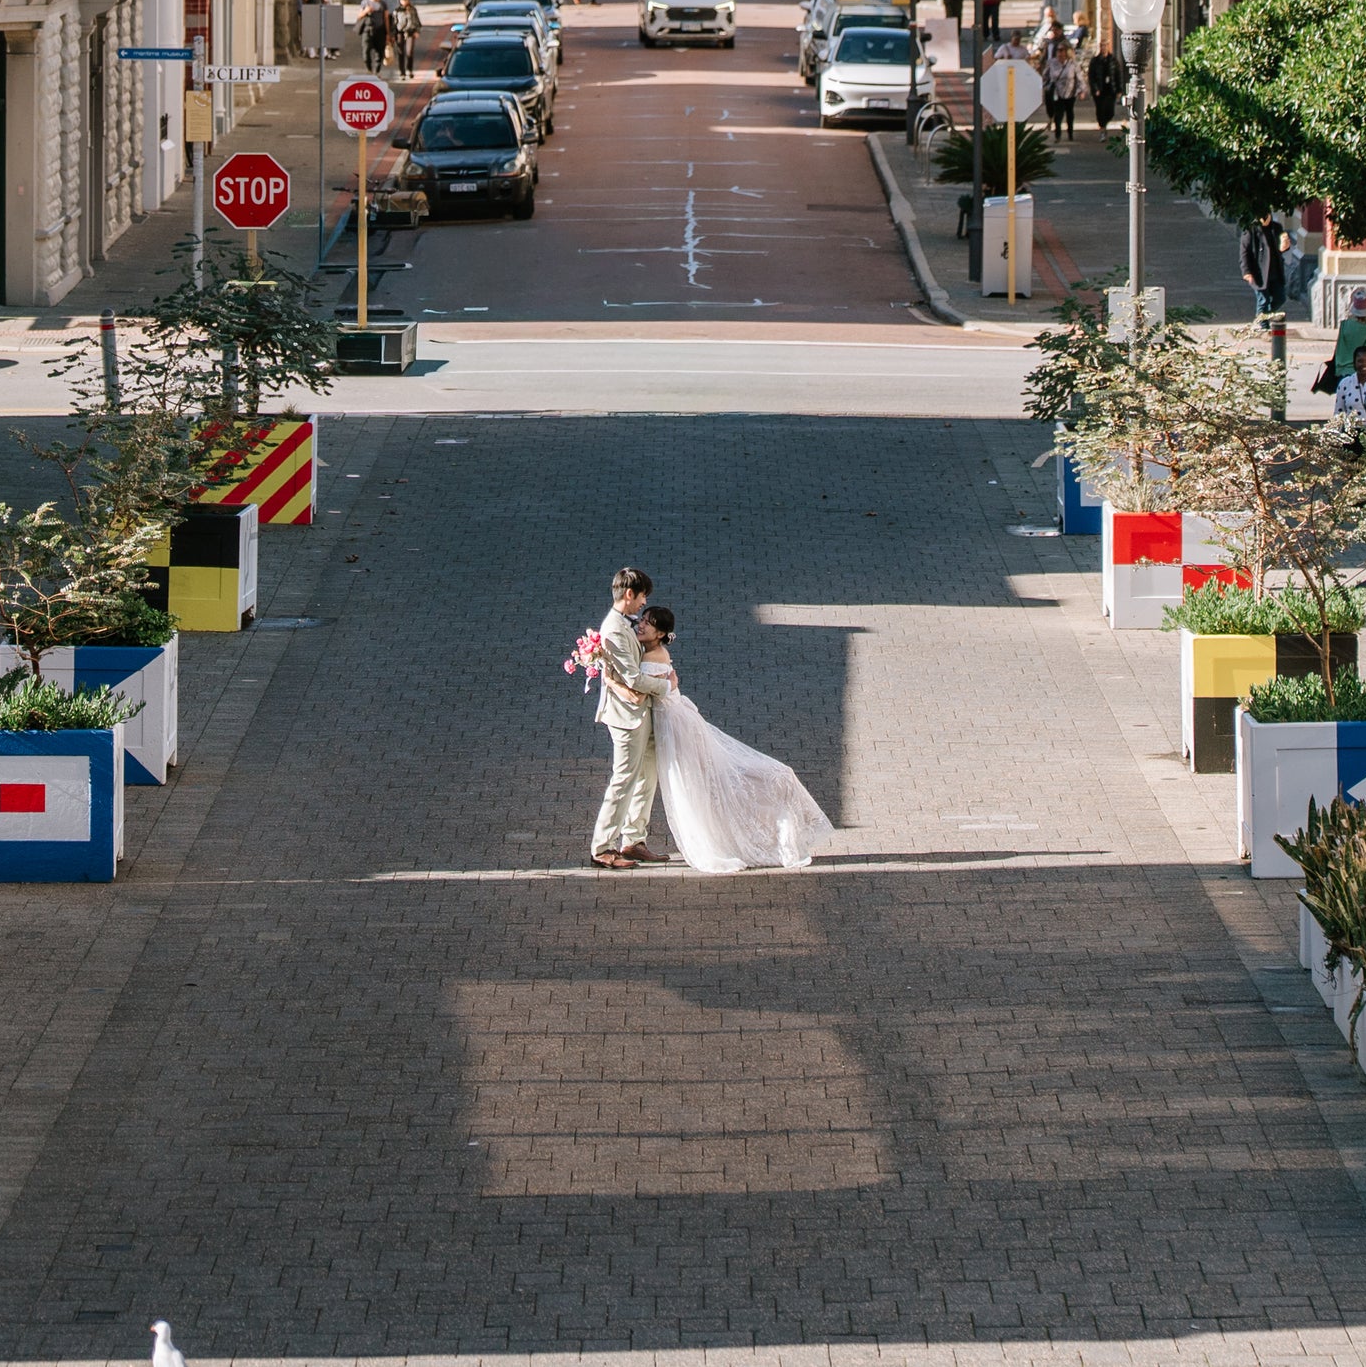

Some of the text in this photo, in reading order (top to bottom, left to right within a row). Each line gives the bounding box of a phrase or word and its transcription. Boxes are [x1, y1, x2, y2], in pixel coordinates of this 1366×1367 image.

[217, 68, 266, 81] CLIFF
[355, 89, 371, 100] NO
[345, 112, 380, 123] ENTRY
[218, 176, 285, 205] STOP
